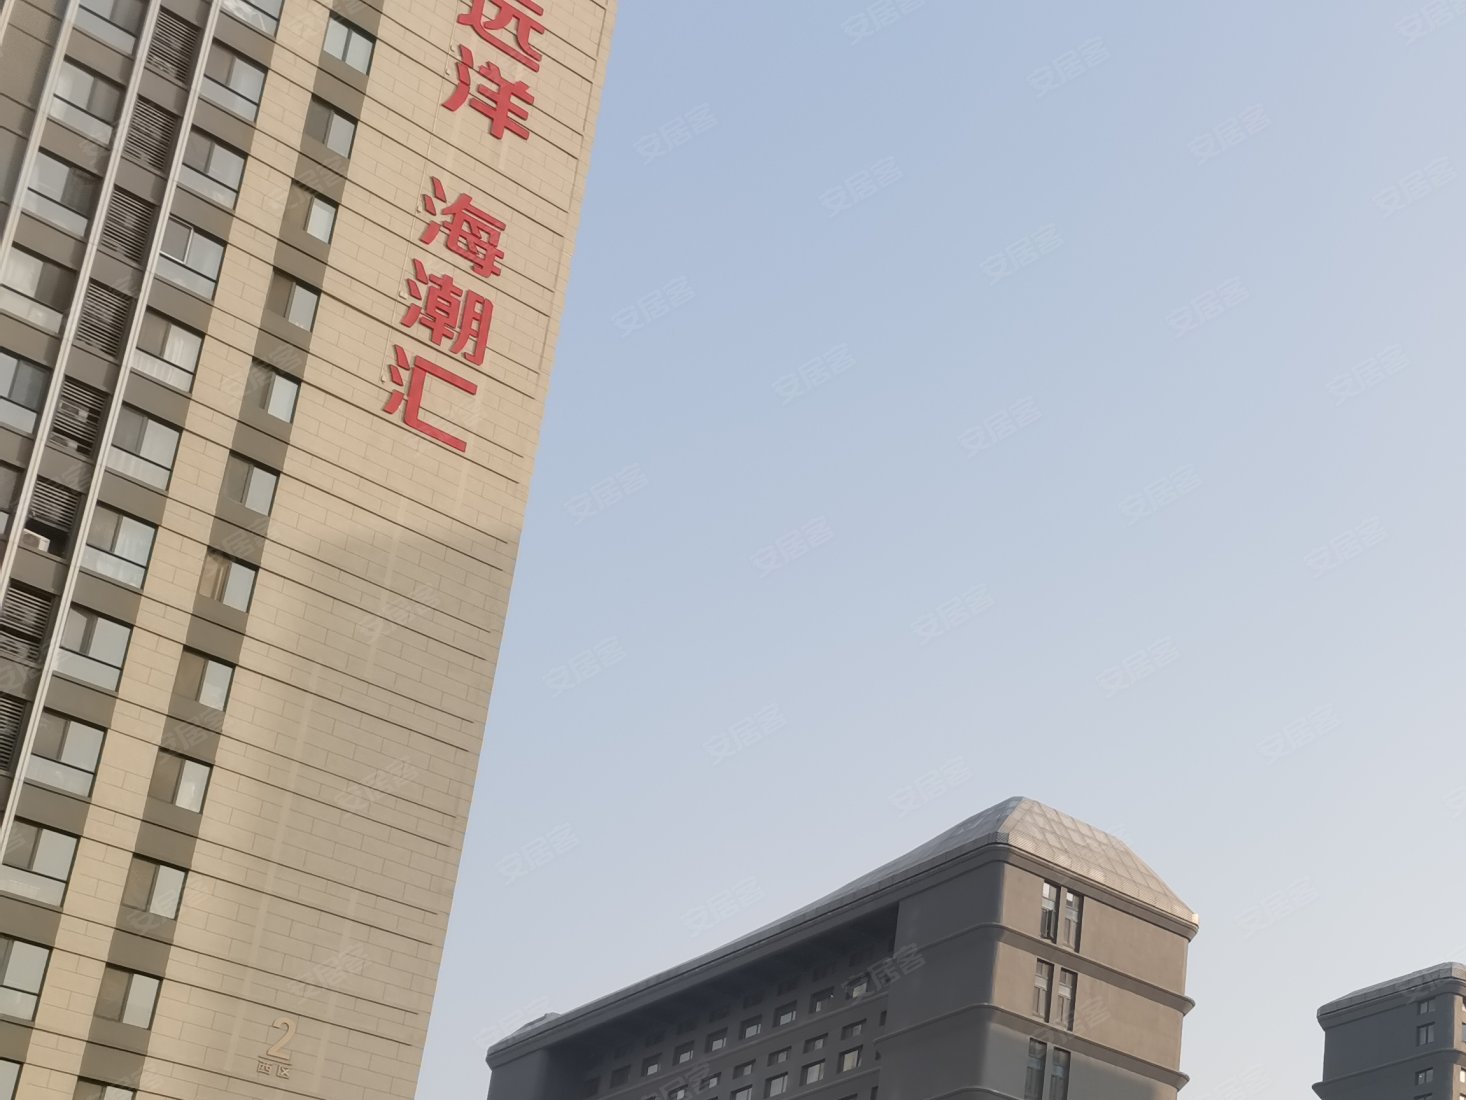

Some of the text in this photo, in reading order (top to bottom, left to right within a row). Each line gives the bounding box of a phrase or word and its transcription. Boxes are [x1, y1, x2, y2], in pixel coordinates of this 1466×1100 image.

[383, 0, 545, 452] 远洋 海潮汇
[266, 1016, 298, 1061] 2
[256, 1060, 293, 1080] 西区
